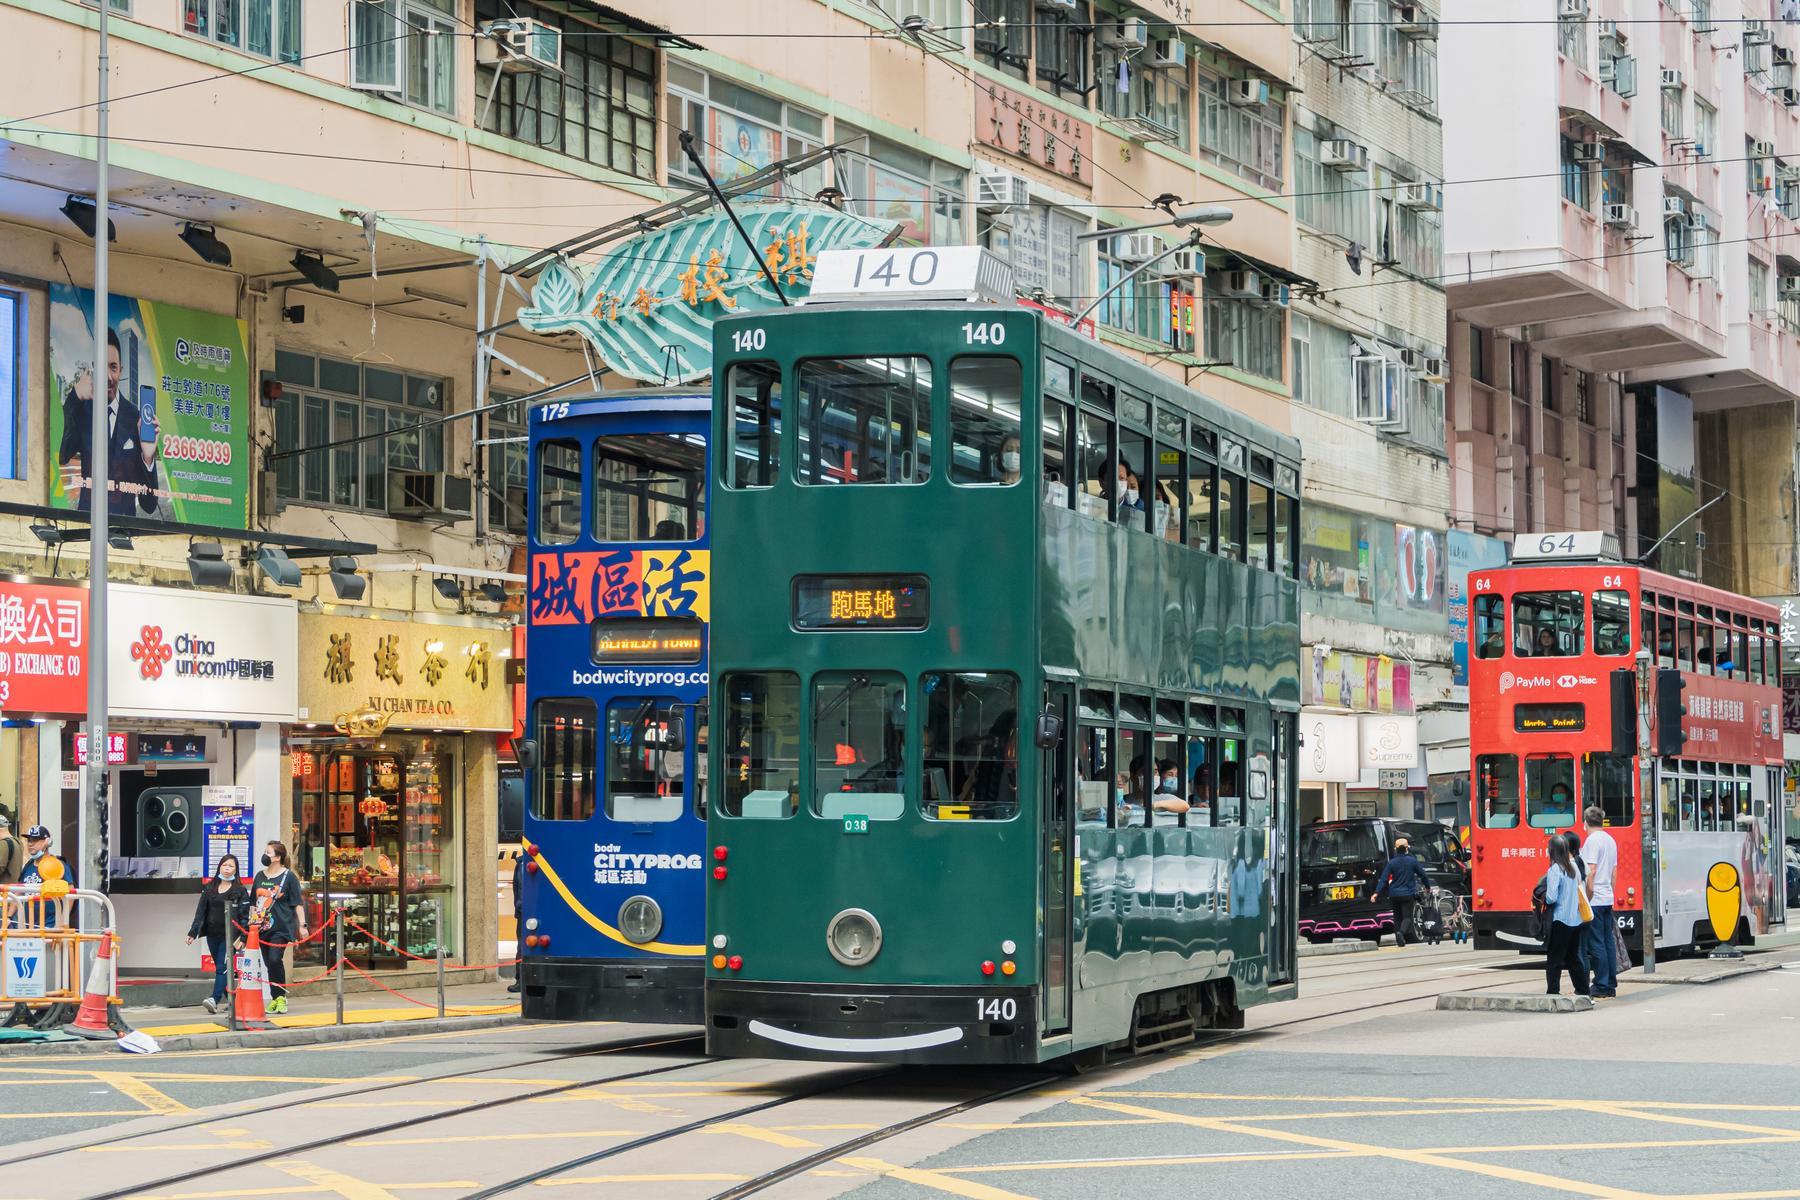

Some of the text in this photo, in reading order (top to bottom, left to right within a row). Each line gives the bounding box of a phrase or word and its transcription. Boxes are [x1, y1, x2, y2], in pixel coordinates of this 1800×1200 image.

[853, 251, 938, 288] 140
[732, 328, 766, 352] 140
[962, 323, 1006, 345] 140
[162, 376, 231, 401] 莊士敦道176號
[174, 398, 231, 421] 美華大廈1樓
[541, 403, 569, 422] 175
[164, 434, 232, 465] 23663939
[1538, 534, 1576, 554] 64
[532, 550, 706, 623] 城區活
[1476, 579, 1491, 590] 64
[1603, 576, 1622, 587] 64
[831, 590, 896, 619] 跑馬地
[1780, 599, 1800, 644] 永安
[175, 633, 215, 656] China
[15, 654, 64, 676] EXCHANGE
[68, 656, 80, 676] CO
[176, 655, 226, 677] unicom
[1516, 676, 1551, 689] PayMe
[369, 697, 454, 715] KI CHAN TEA CO.
[1380, 722, 1401, 750] 3
[1369, 748, 1413, 763] Supreme
[845, 820, 867, 831] 038
[594, 844, 621, 853] bodw
[594, 854, 702, 869] CITYPROG
[594, 870, 647, 884] 城區活動
[1617, 916, 1635, 928] 64
[977, 998, 1017, 1021] 140
